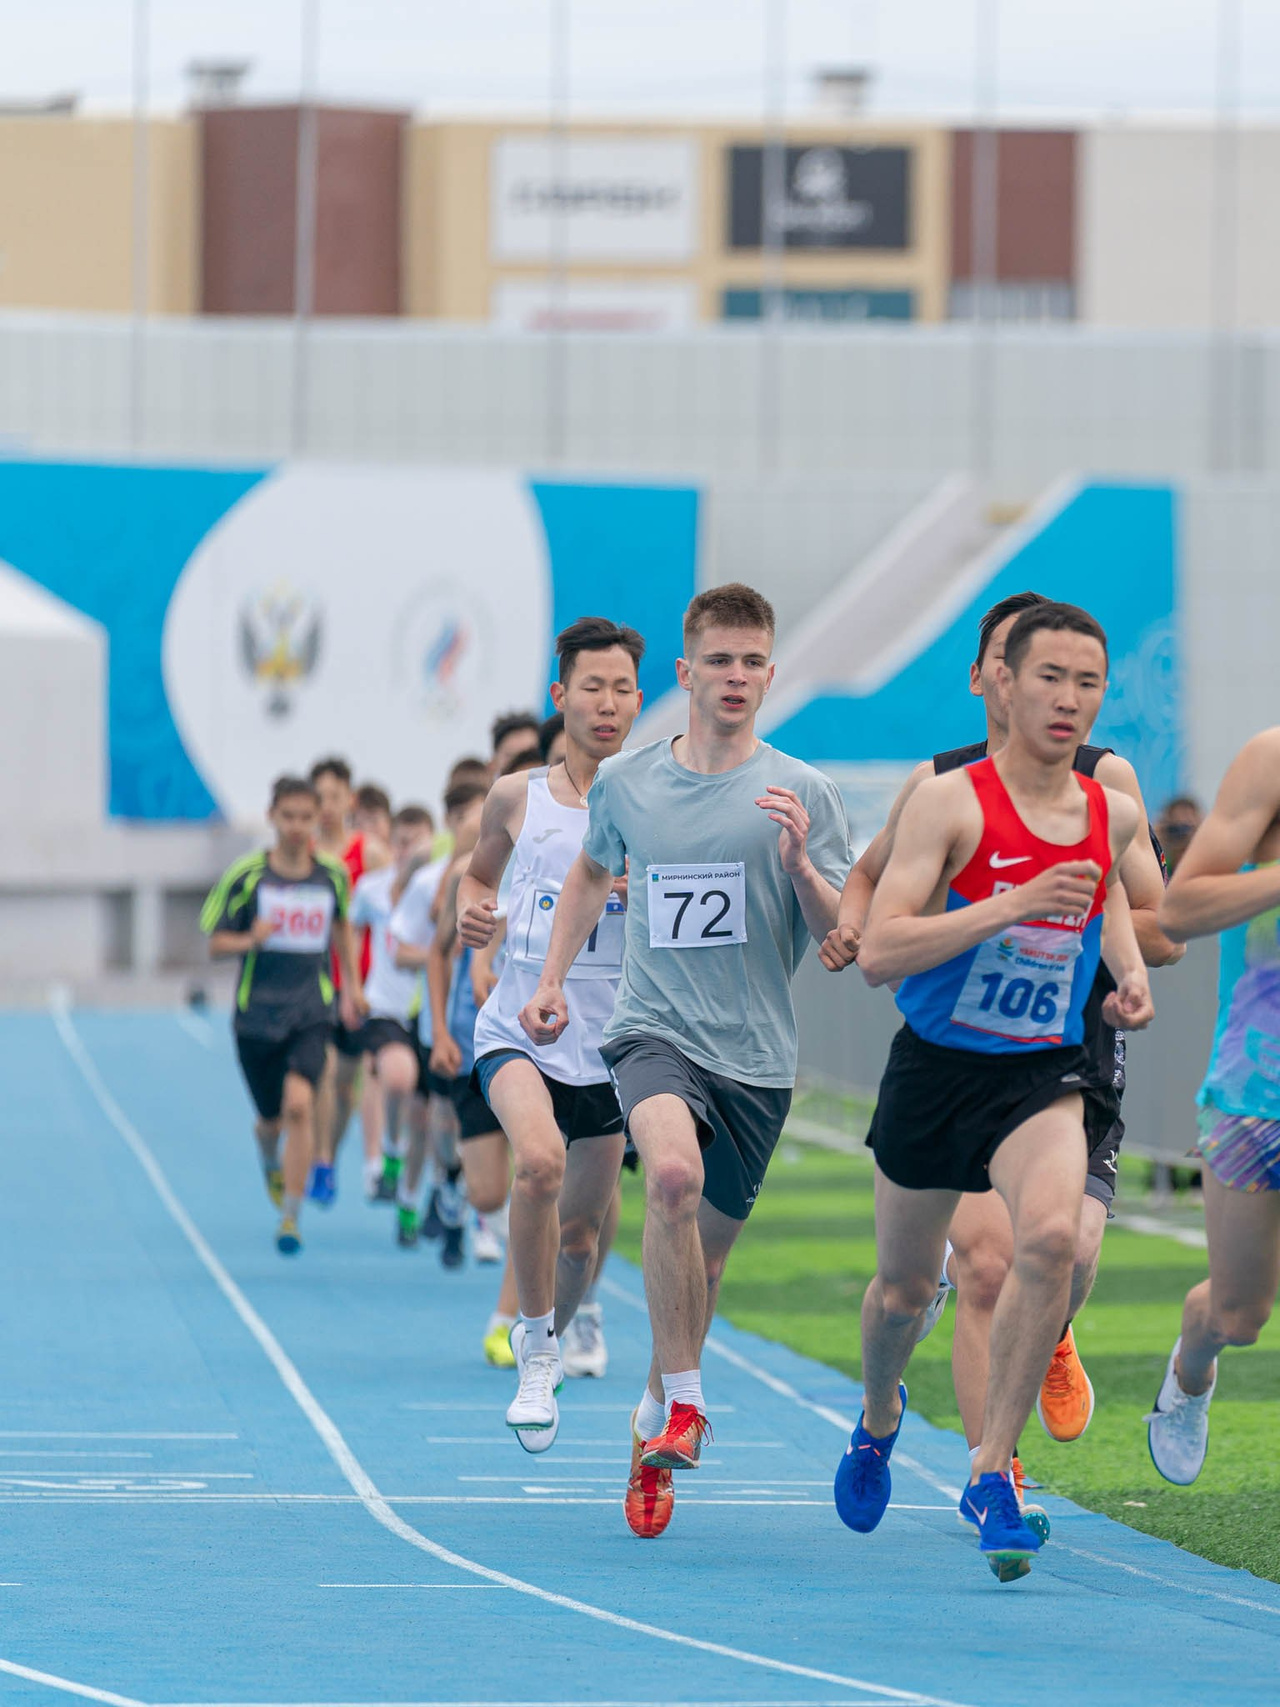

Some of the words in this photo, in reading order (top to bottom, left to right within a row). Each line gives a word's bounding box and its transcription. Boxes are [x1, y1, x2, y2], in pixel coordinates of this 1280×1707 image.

[662, 872, 713, 880] МИРНИНСКИЙ
[715, 871, 740, 879] РАЙОН
[664, 890, 732, 940] 72
[978, 972, 1060, 1024] 106
